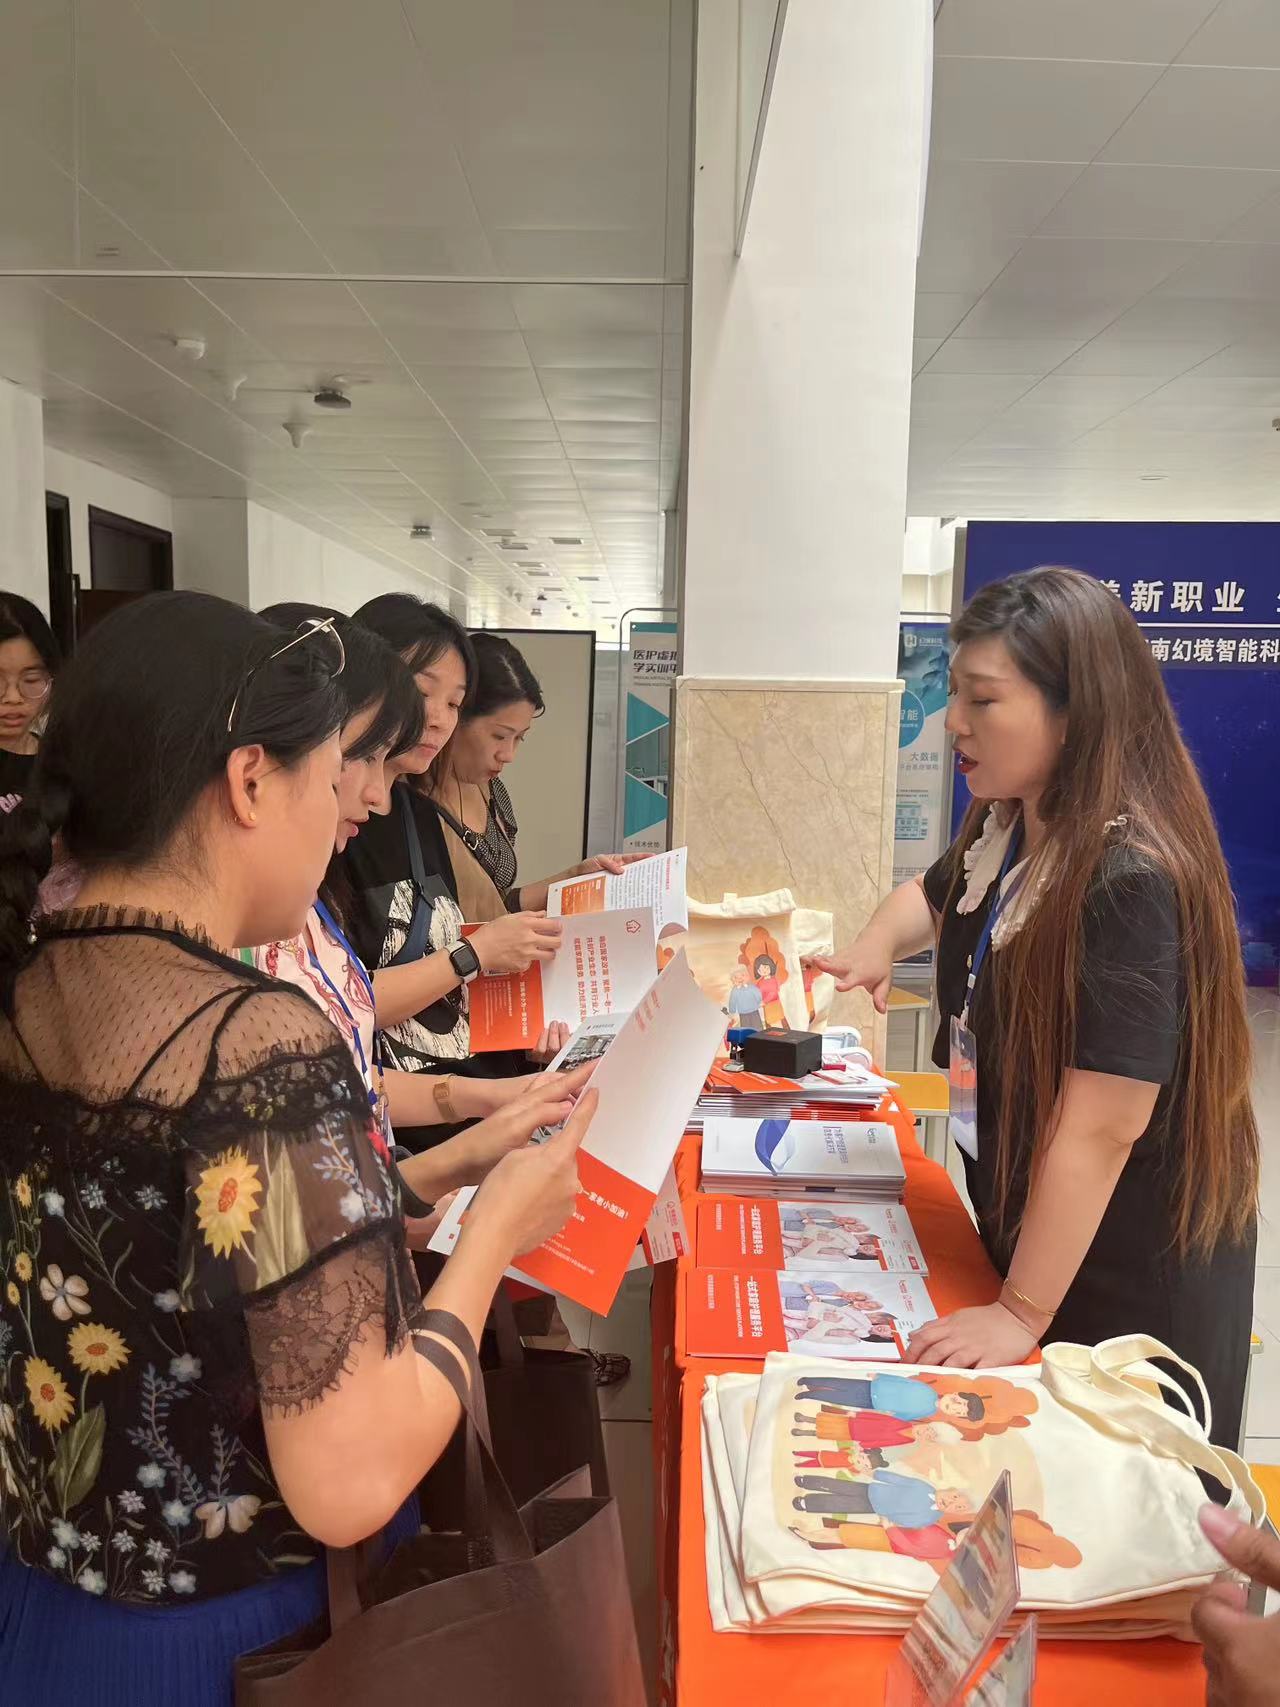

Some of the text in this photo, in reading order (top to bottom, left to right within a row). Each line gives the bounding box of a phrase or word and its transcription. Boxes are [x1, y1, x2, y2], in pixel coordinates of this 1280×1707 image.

[1146, 637, 1280, 663] 南幻境智能科
